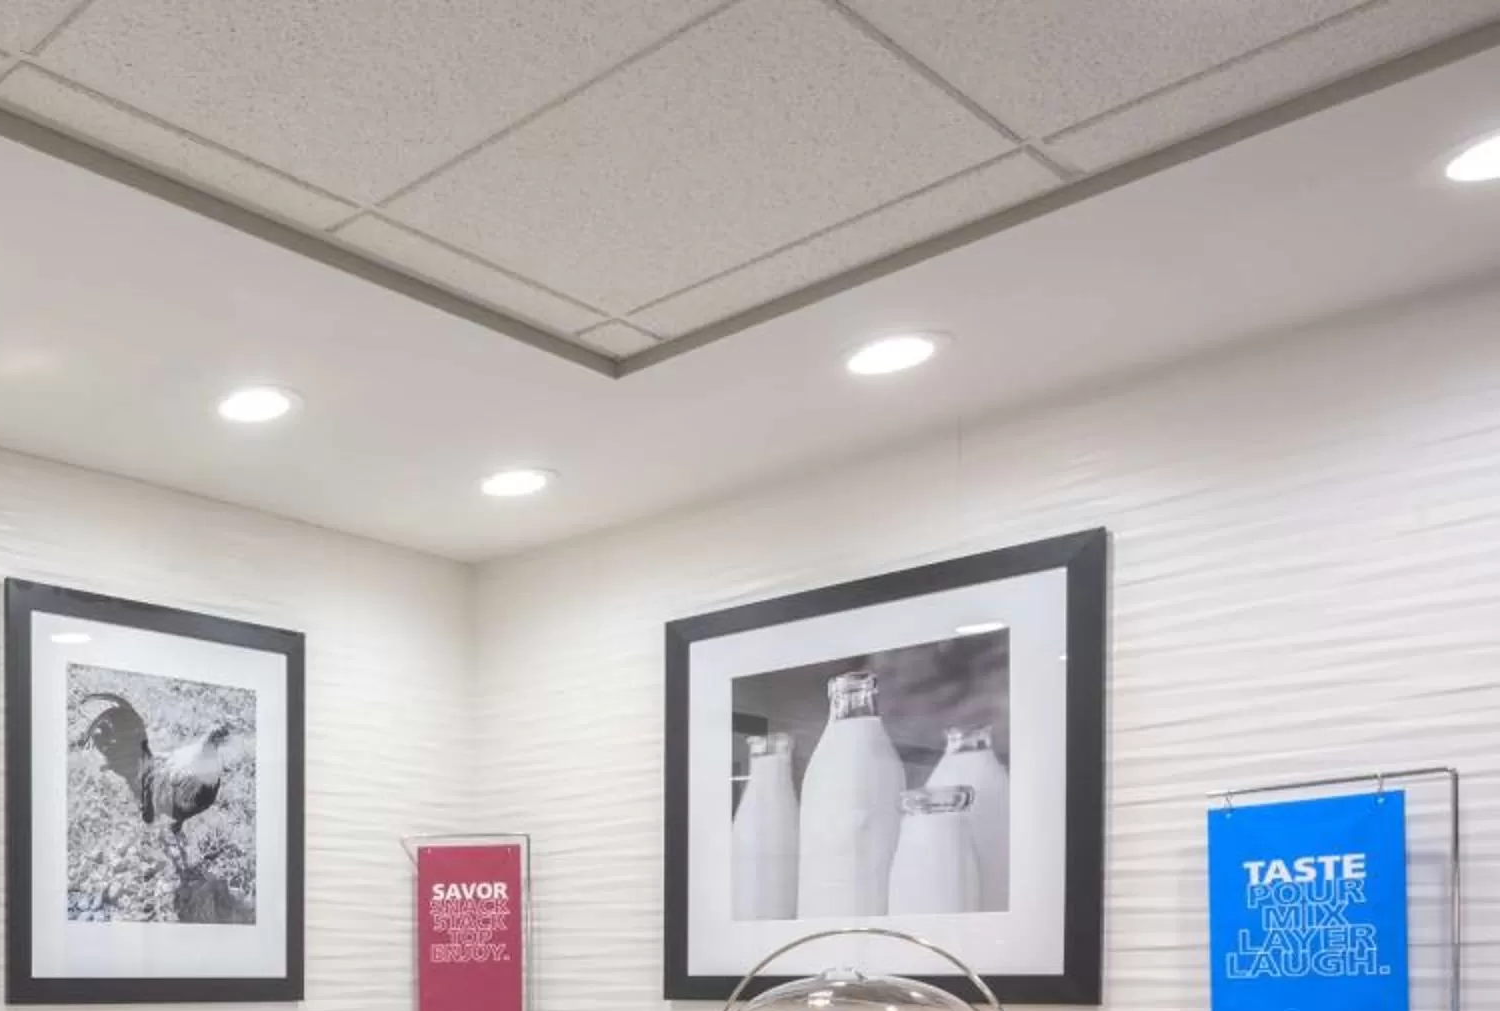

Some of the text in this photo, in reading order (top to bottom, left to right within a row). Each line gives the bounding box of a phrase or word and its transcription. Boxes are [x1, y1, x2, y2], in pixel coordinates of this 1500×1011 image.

[1243, 852, 1367, 886] TASTE
[431, 882, 509, 901] SAVOR
[1247, 877, 1367, 909] POUR
[1261, 902, 1349, 932] MIX
[1239, 923, 1377, 956] LAYER
[1225, 948, 1392, 980] LAUGH.
